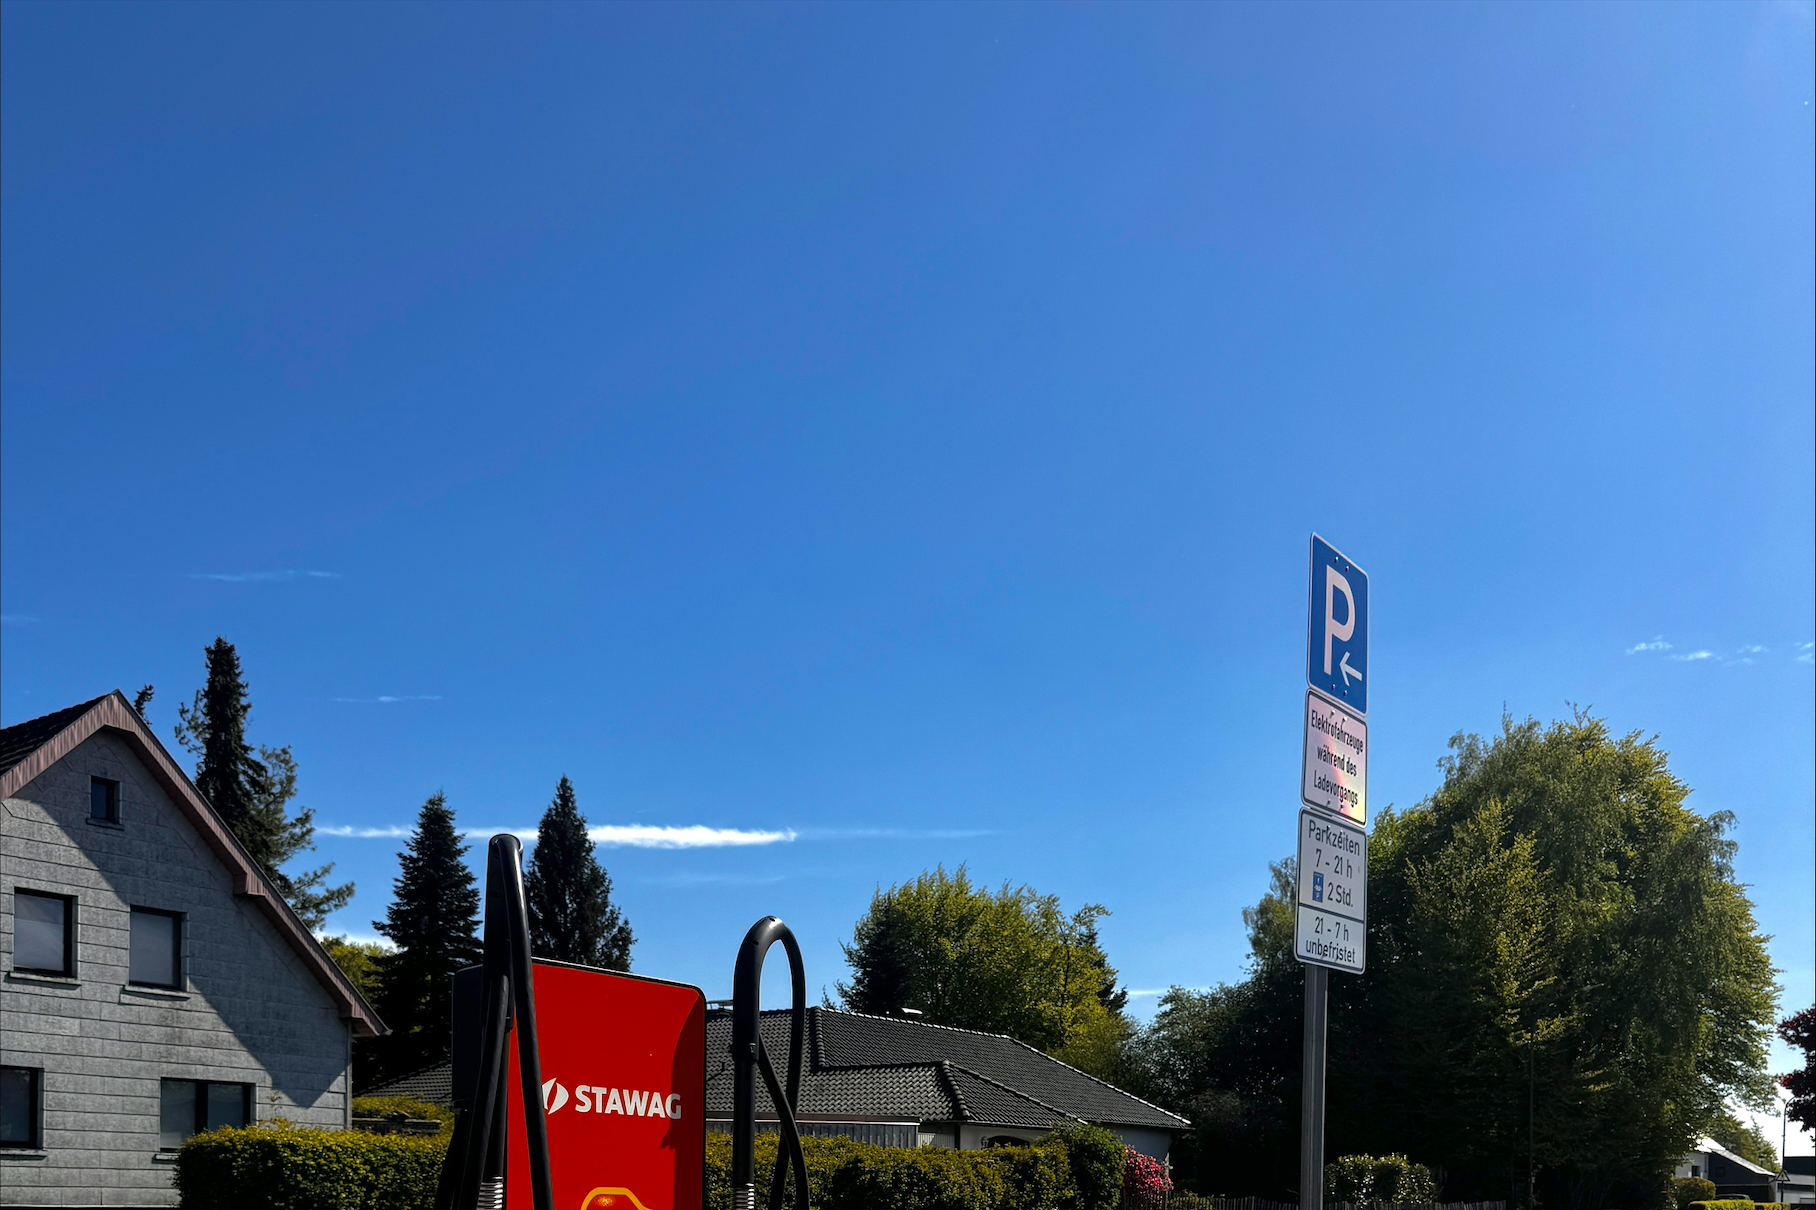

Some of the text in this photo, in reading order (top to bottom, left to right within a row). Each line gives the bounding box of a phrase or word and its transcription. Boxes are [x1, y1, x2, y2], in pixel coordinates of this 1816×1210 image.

[1323, 564, 1356, 676] P
[1311, 709, 1364, 756] Elektrofahrzeuge
[1317, 744, 1357, 777] während des
[1313, 769, 1358, 808] Ladevorgangs
[1308, 819, 1360, 856] Parkzeiten
[1315, 848, 1322, 868] 7
[1334, 855, 1343, 876] 21
[1346, 859, 1353, 879] h
[1327, 882, 1354, 908] 2 Std.
[1314, 916, 1324, 935] 21
[1335, 922, 1341, 939] 7
[1343, 924, 1349, 942] h
[1305, 938, 1356, 964] unbefristet
[574, 1084, 682, 1120] STAWAG
